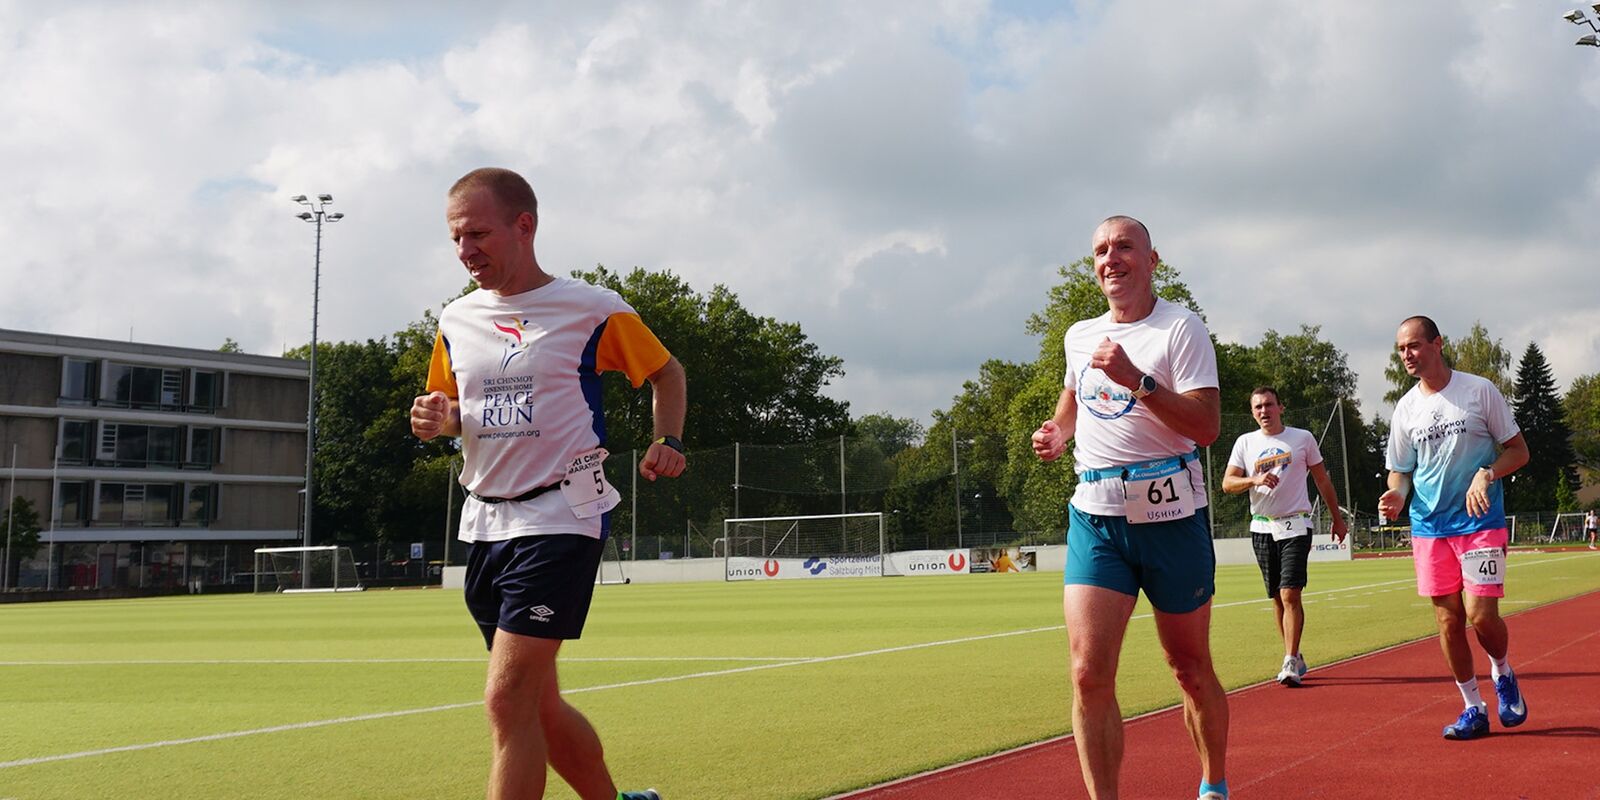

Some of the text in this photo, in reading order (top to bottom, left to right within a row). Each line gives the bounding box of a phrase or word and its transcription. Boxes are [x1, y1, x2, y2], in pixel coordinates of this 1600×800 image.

[497, 375, 534, 385] CHINMOY
[484, 391, 533, 407] PEACE
[482, 405, 533, 428] RUN
[1428, 419, 1466, 433] CHINMOY
[477, 430, 540, 440] www.peacerun.org
[1418, 427, 1467, 442] MARATHON
[568, 460, 600, 474] MARATHO
[593, 470, 604, 495] 5
[1147, 477, 1180, 505] 61
[1147, 508, 1183, 521] USHIKA
[1285, 520, 1292, 531] 2
[829, 554, 881, 564] Sportzentru
[728, 568, 762, 577] union
[865, 565, 881, 575] Mitt
[909, 562, 946, 571] union
[1479, 560, 1497, 576] 40
